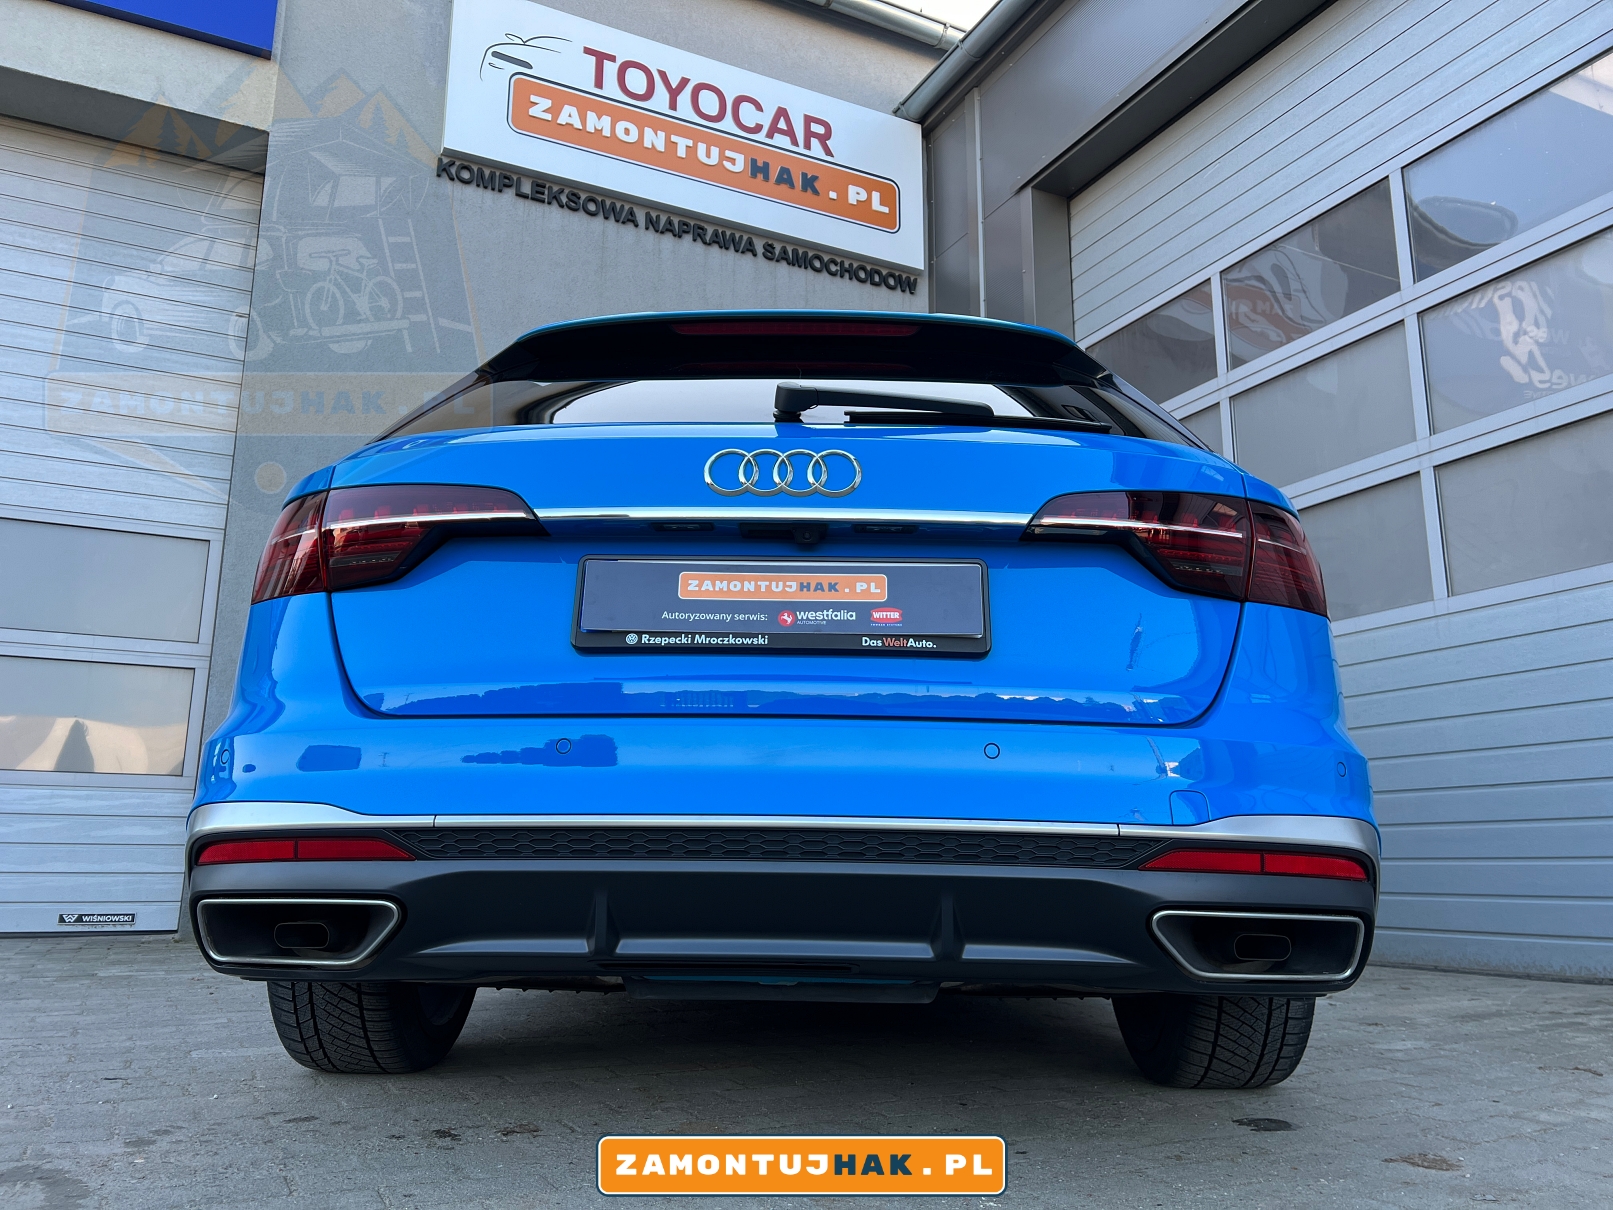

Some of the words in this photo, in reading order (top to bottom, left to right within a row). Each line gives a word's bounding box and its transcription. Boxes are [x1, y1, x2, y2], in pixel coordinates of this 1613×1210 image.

[583, 45, 834, 158] TOYOCAR
[436, 157, 639, 227] KOMPLEKSOWA
[645, 211, 757, 257] NAPRAWA
[662, 611, 732, 622] Autoryzowany
[734, 612, 768, 621] serwis:
[797, 609, 856, 620] westfalia
[872, 611, 900, 619] WITTER
[641, 634, 691, 646] Rzepecki
[694, 634, 768, 645] Mroczkowski
[82, 914, 131, 922] WIŚNIOWSKI
